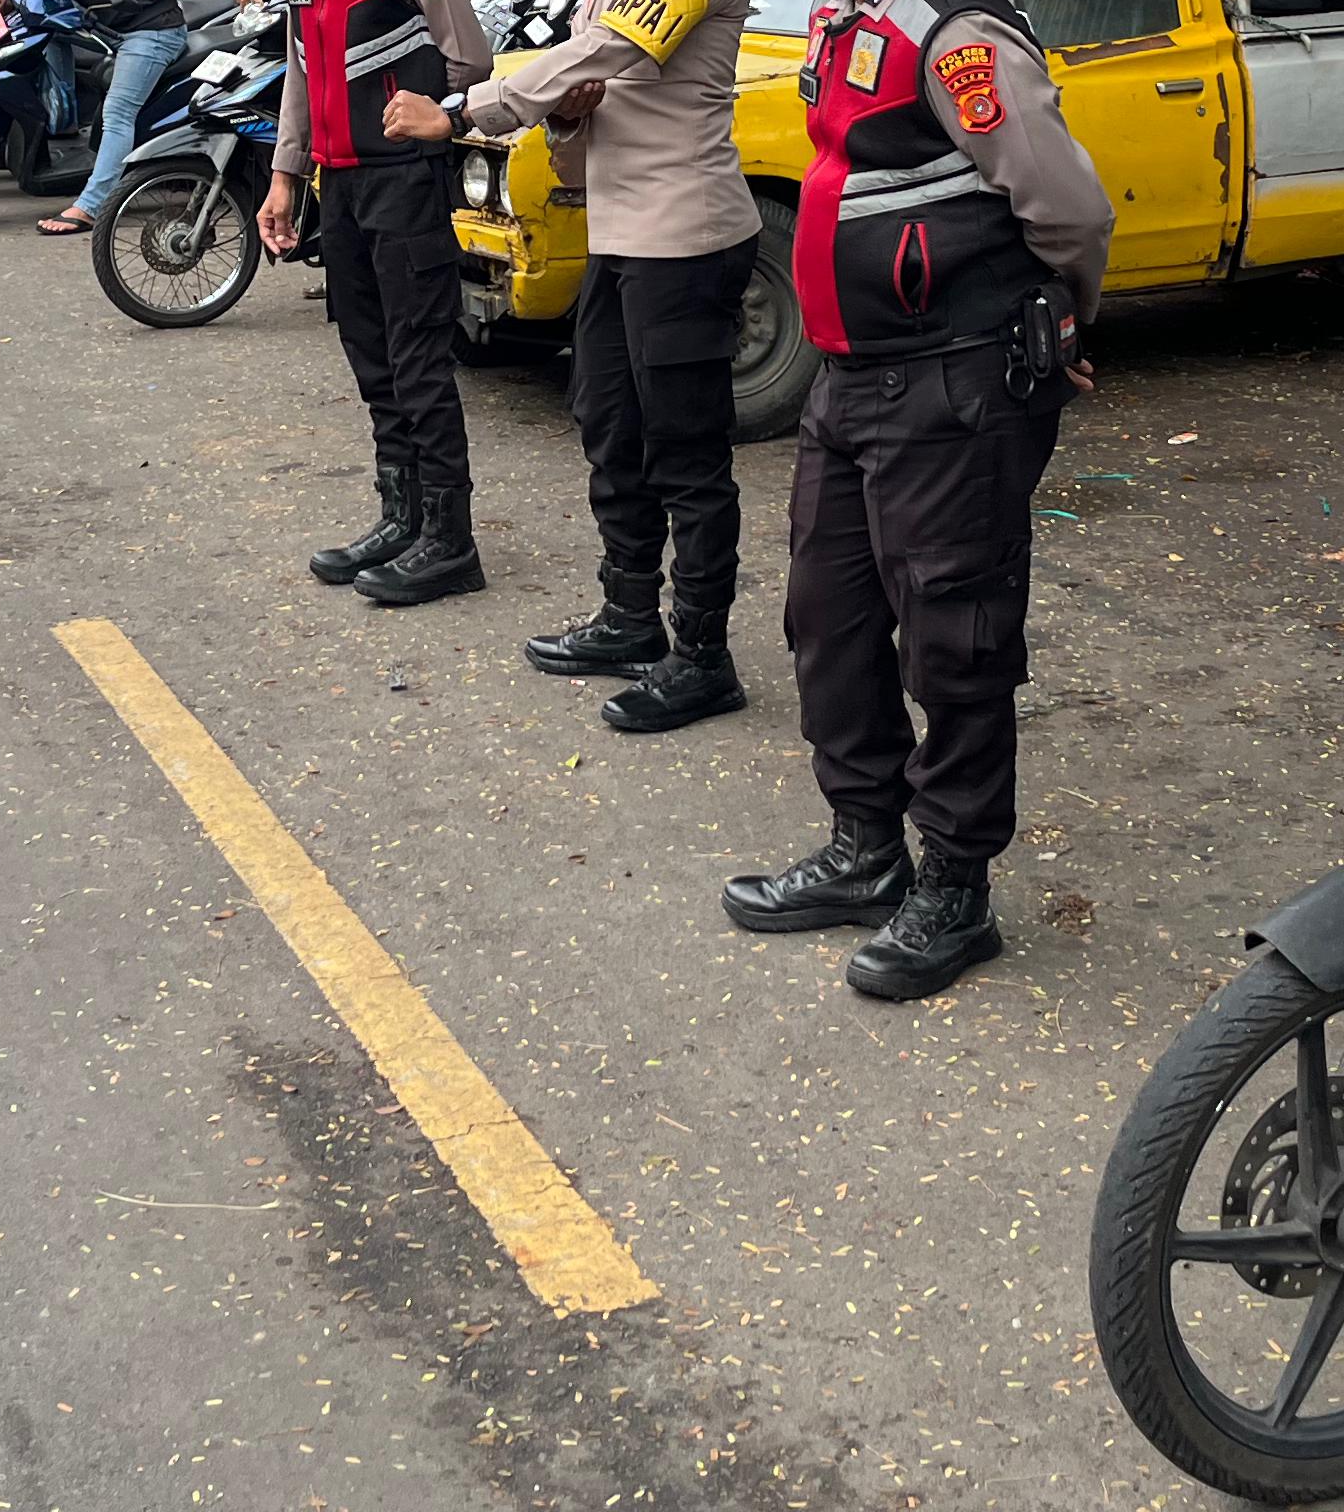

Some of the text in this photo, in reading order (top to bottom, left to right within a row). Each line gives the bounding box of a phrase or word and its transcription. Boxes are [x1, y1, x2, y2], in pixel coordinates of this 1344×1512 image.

[939, 47, 986, 69] POLRES
[953, 72, 986, 90] ACEH
[229, 114, 260, 125] HONDA
